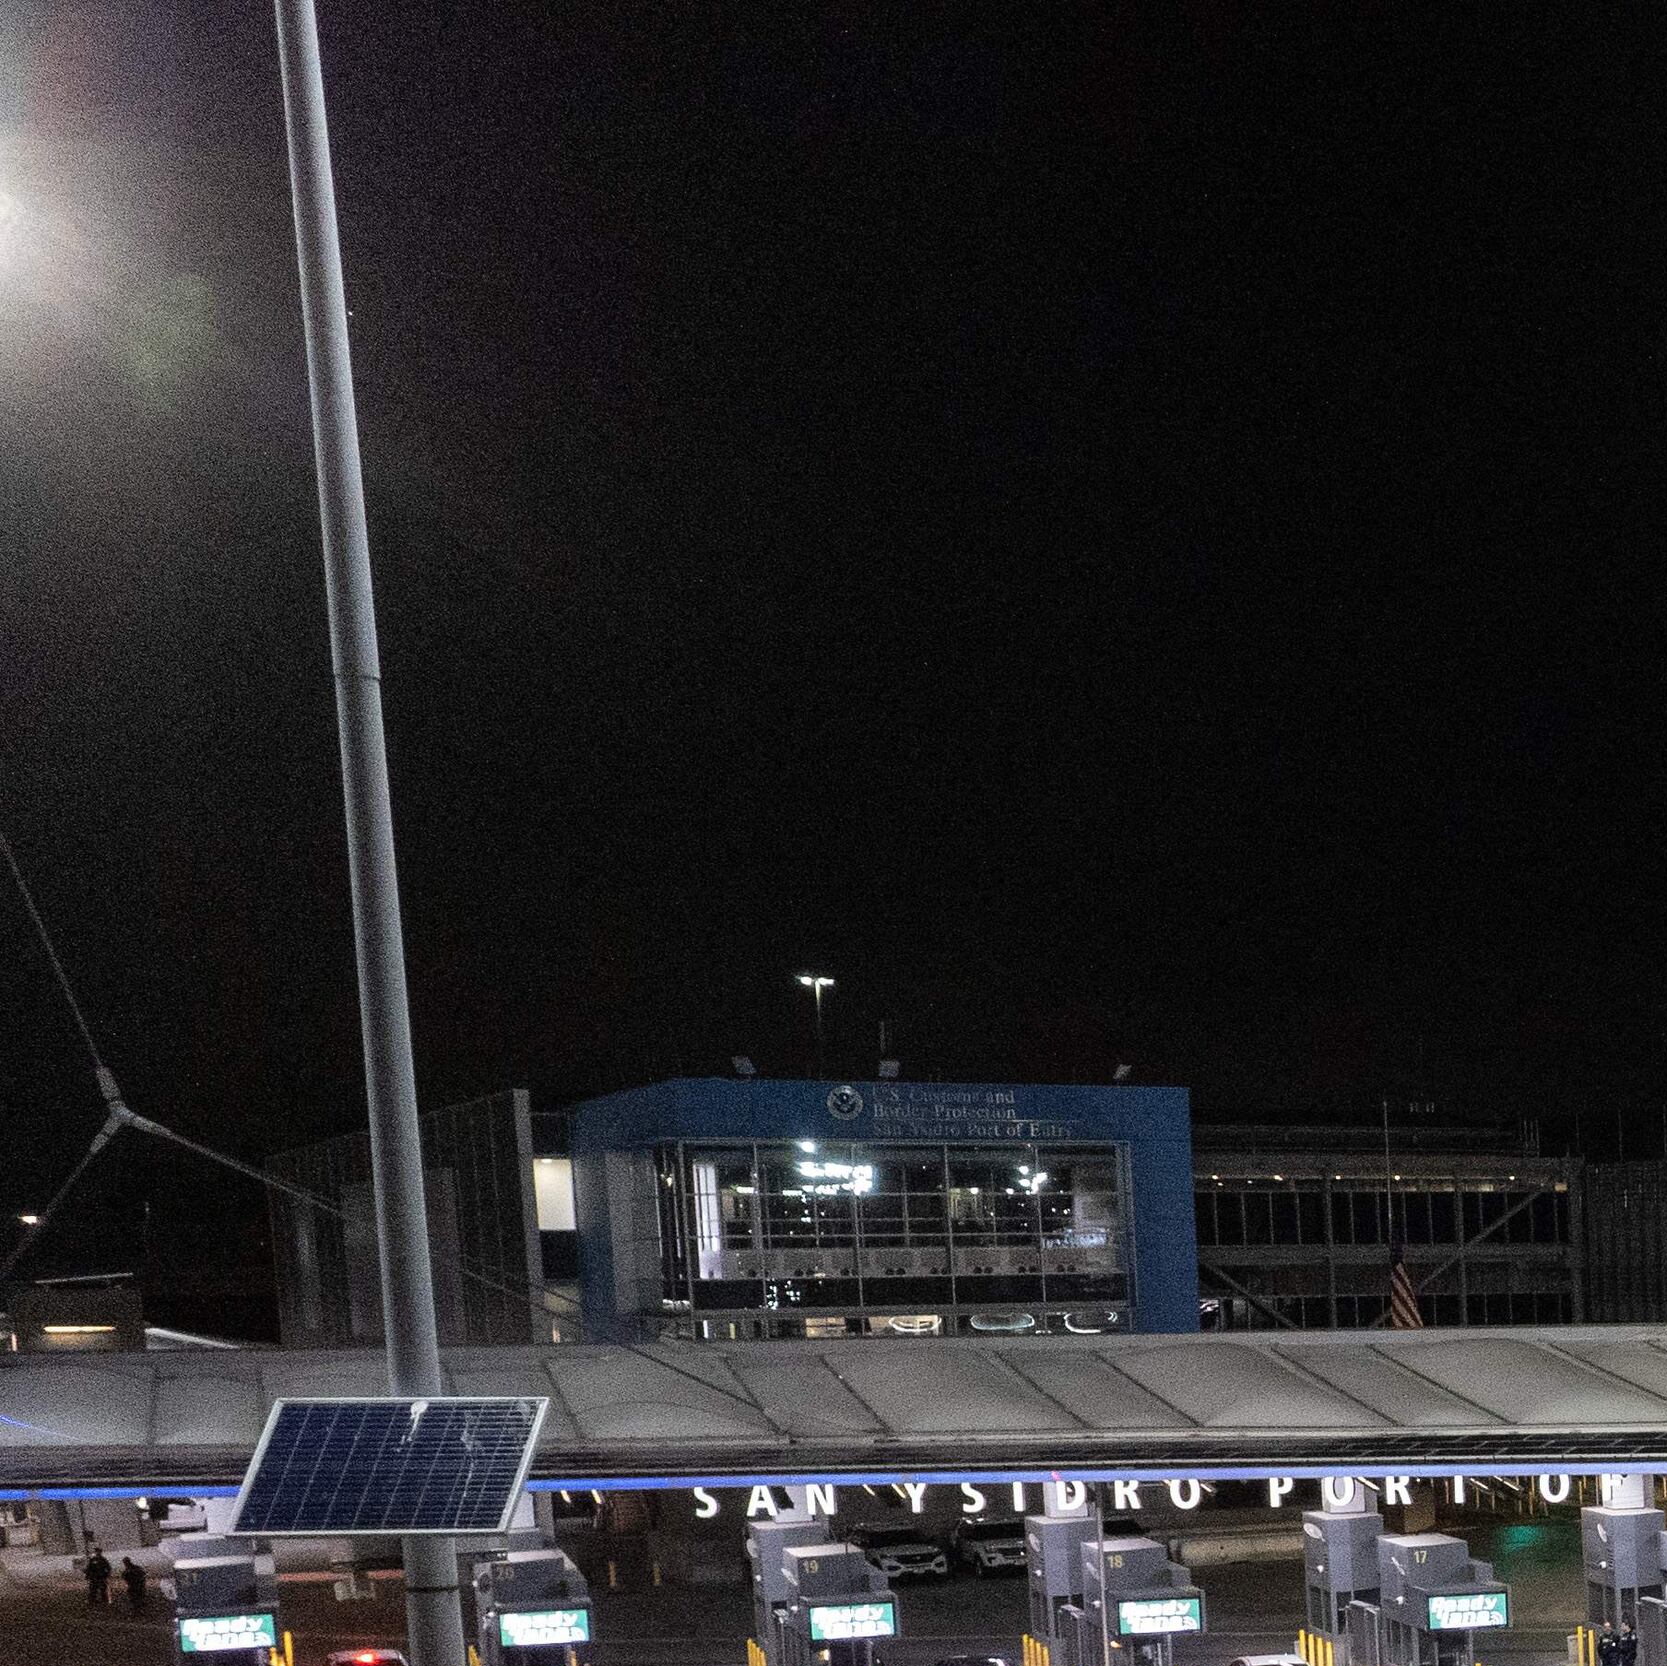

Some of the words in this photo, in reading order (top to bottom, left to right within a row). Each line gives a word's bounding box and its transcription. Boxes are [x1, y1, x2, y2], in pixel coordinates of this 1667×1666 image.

[984, 1090, 1015, 1105] and
[874, 1104, 927, 1118] Border
[934, 1104, 1016, 1120] Protection
[967, 1123, 1000, 1137] Port
[1006, 1122, 1023, 1137] of
[1029, 1122, 1071, 1139] Entry
[693, 1483, 835, 1518] SAN
[904, 1477, 1202, 1514] YSIDRO
[1539, 1472, 1623, 1504] OF
[1107, 1555, 1124, 1569] 18
[1414, 1550, 1428, 1564] 17
[803, 1560, 819, 1575] 19
[1122, 1600, 1191, 1618] Ready
[1430, 1595, 1497, 1612] Ready
